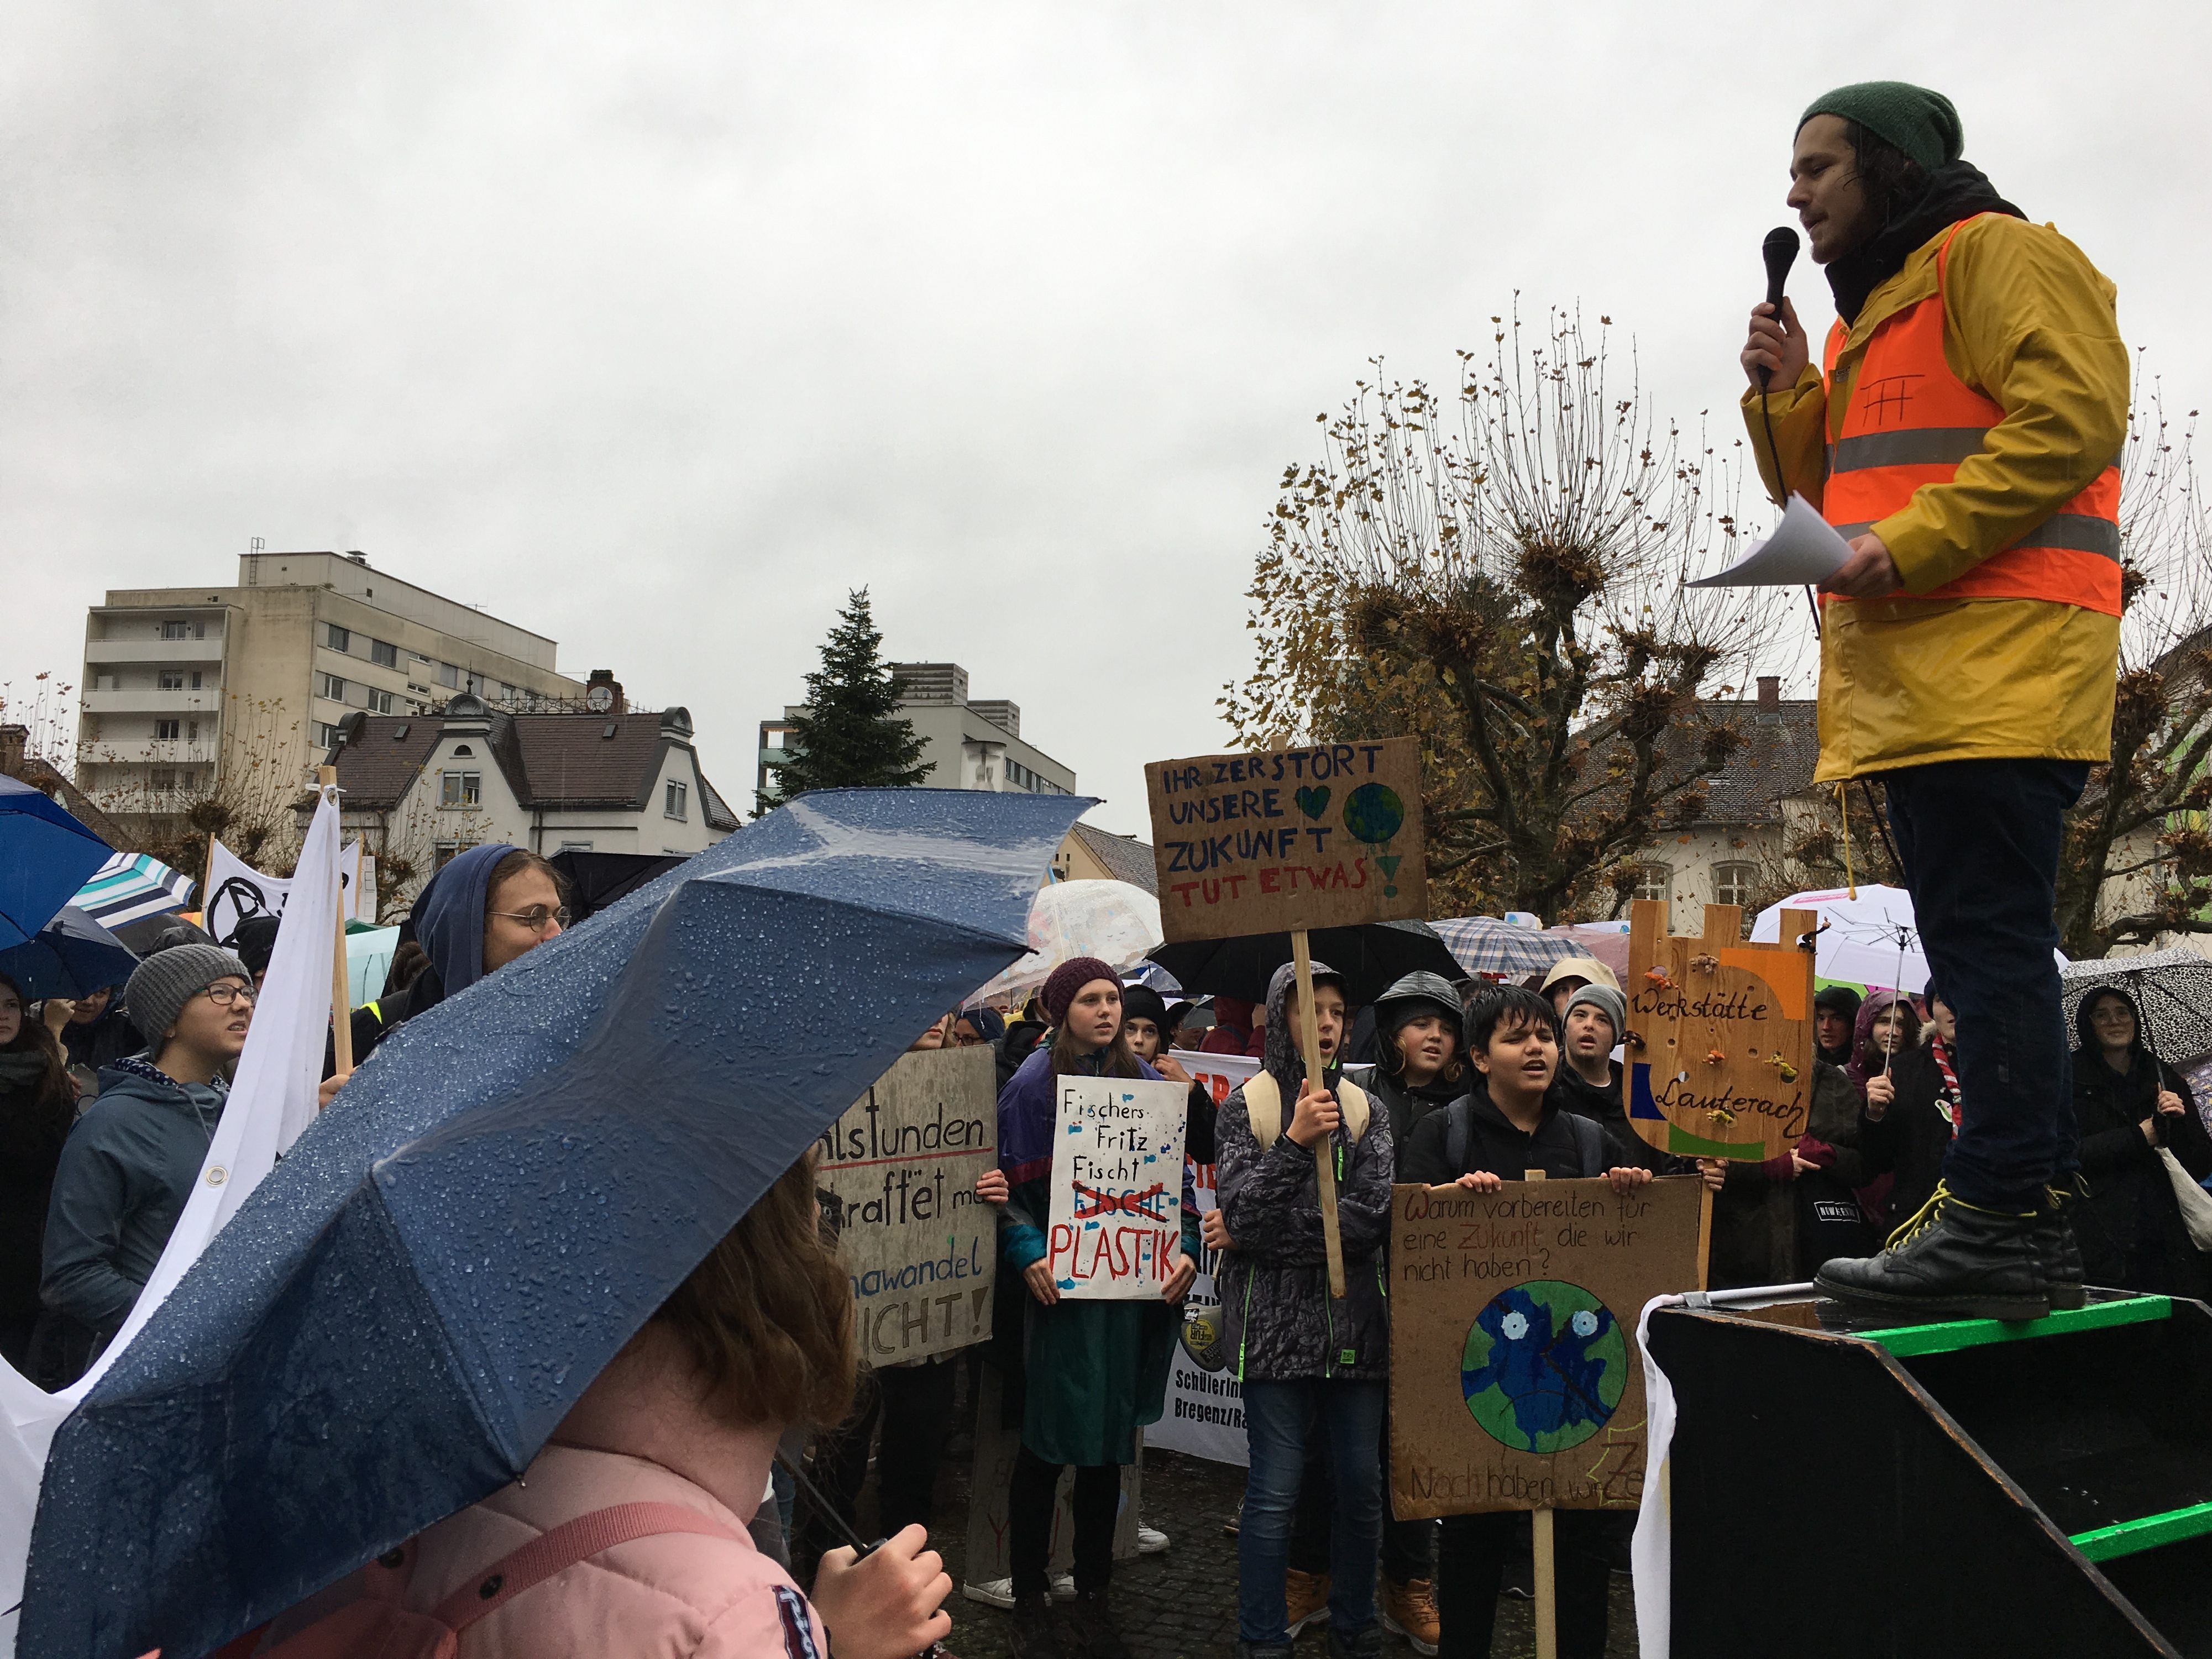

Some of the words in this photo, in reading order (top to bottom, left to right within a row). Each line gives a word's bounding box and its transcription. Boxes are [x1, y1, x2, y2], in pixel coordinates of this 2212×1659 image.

[1163, 765, 1202, 794] IHR
[1168, 788, 1284, 825] UNSERE
[1164, 827, 1333, 873] ZUKUNFT
[1171, 874, 1247, 907] TUT
[1632, 987, 1769, 1021] Werkstätte
[1064, 1089, 1144, 1119] Fischers
[1654, 1077, 1805, 1140] Lauterach
[1097, 1124, 1147, 1152] Fritz
[1073, 1154, 1139, 1182] Fischt
[841, 1167, 945, 1228] raftet
[1404, 1190, 1475, 1221] Warum
[1483, 1190, 1604, 1219] vorbereiten
[1617, 1191, 1650, 1222] für
[1050, 1224, 1179, 1282] PLASTIK
[1403, 1226, 1446, 1250] eine
[1458, 1221, 1540, 1254] Zukunft
[1558, 1221, 1587, 1247] die
[1605, 1224, 1637, 1247] wir
[1404, 1255, 1451, 1282] nicht
[856, 1285, 989, 1360] ICHT!
[1487, 1465, 1554, 1501] haben
[1601, 1441, 1645, 1501] Ze
